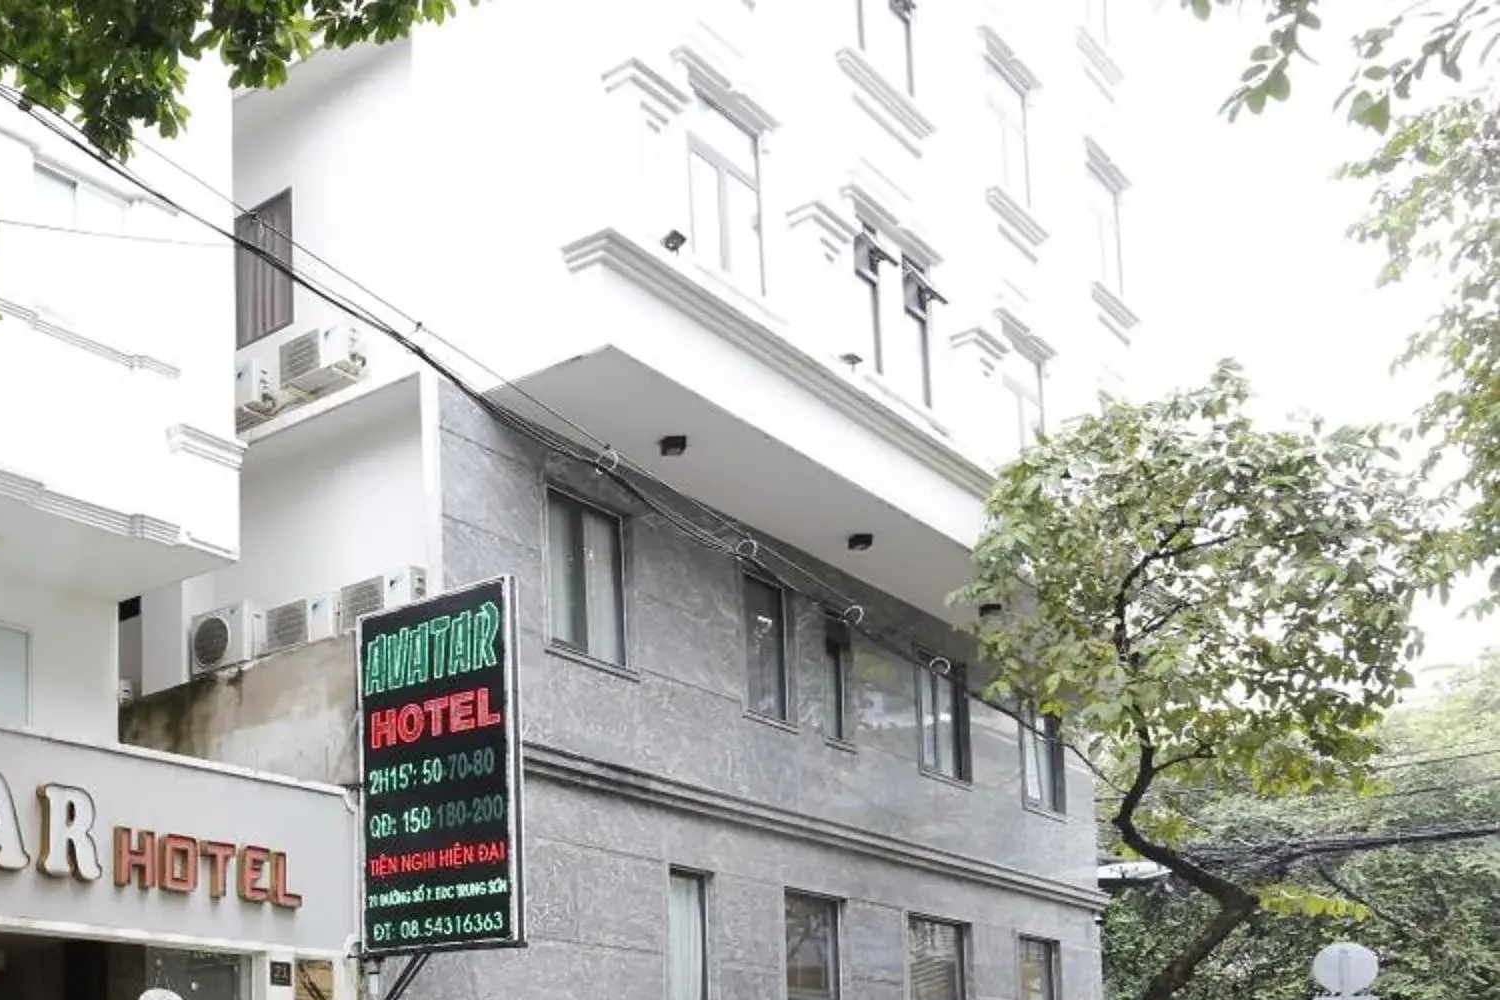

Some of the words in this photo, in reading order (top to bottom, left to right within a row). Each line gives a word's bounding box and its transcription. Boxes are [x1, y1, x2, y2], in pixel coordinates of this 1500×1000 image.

[365, 600, 499, 696] AVATAR
[371, 687, 501, 748] HOTEL
[113, 826, 303, 909] HOTEL
